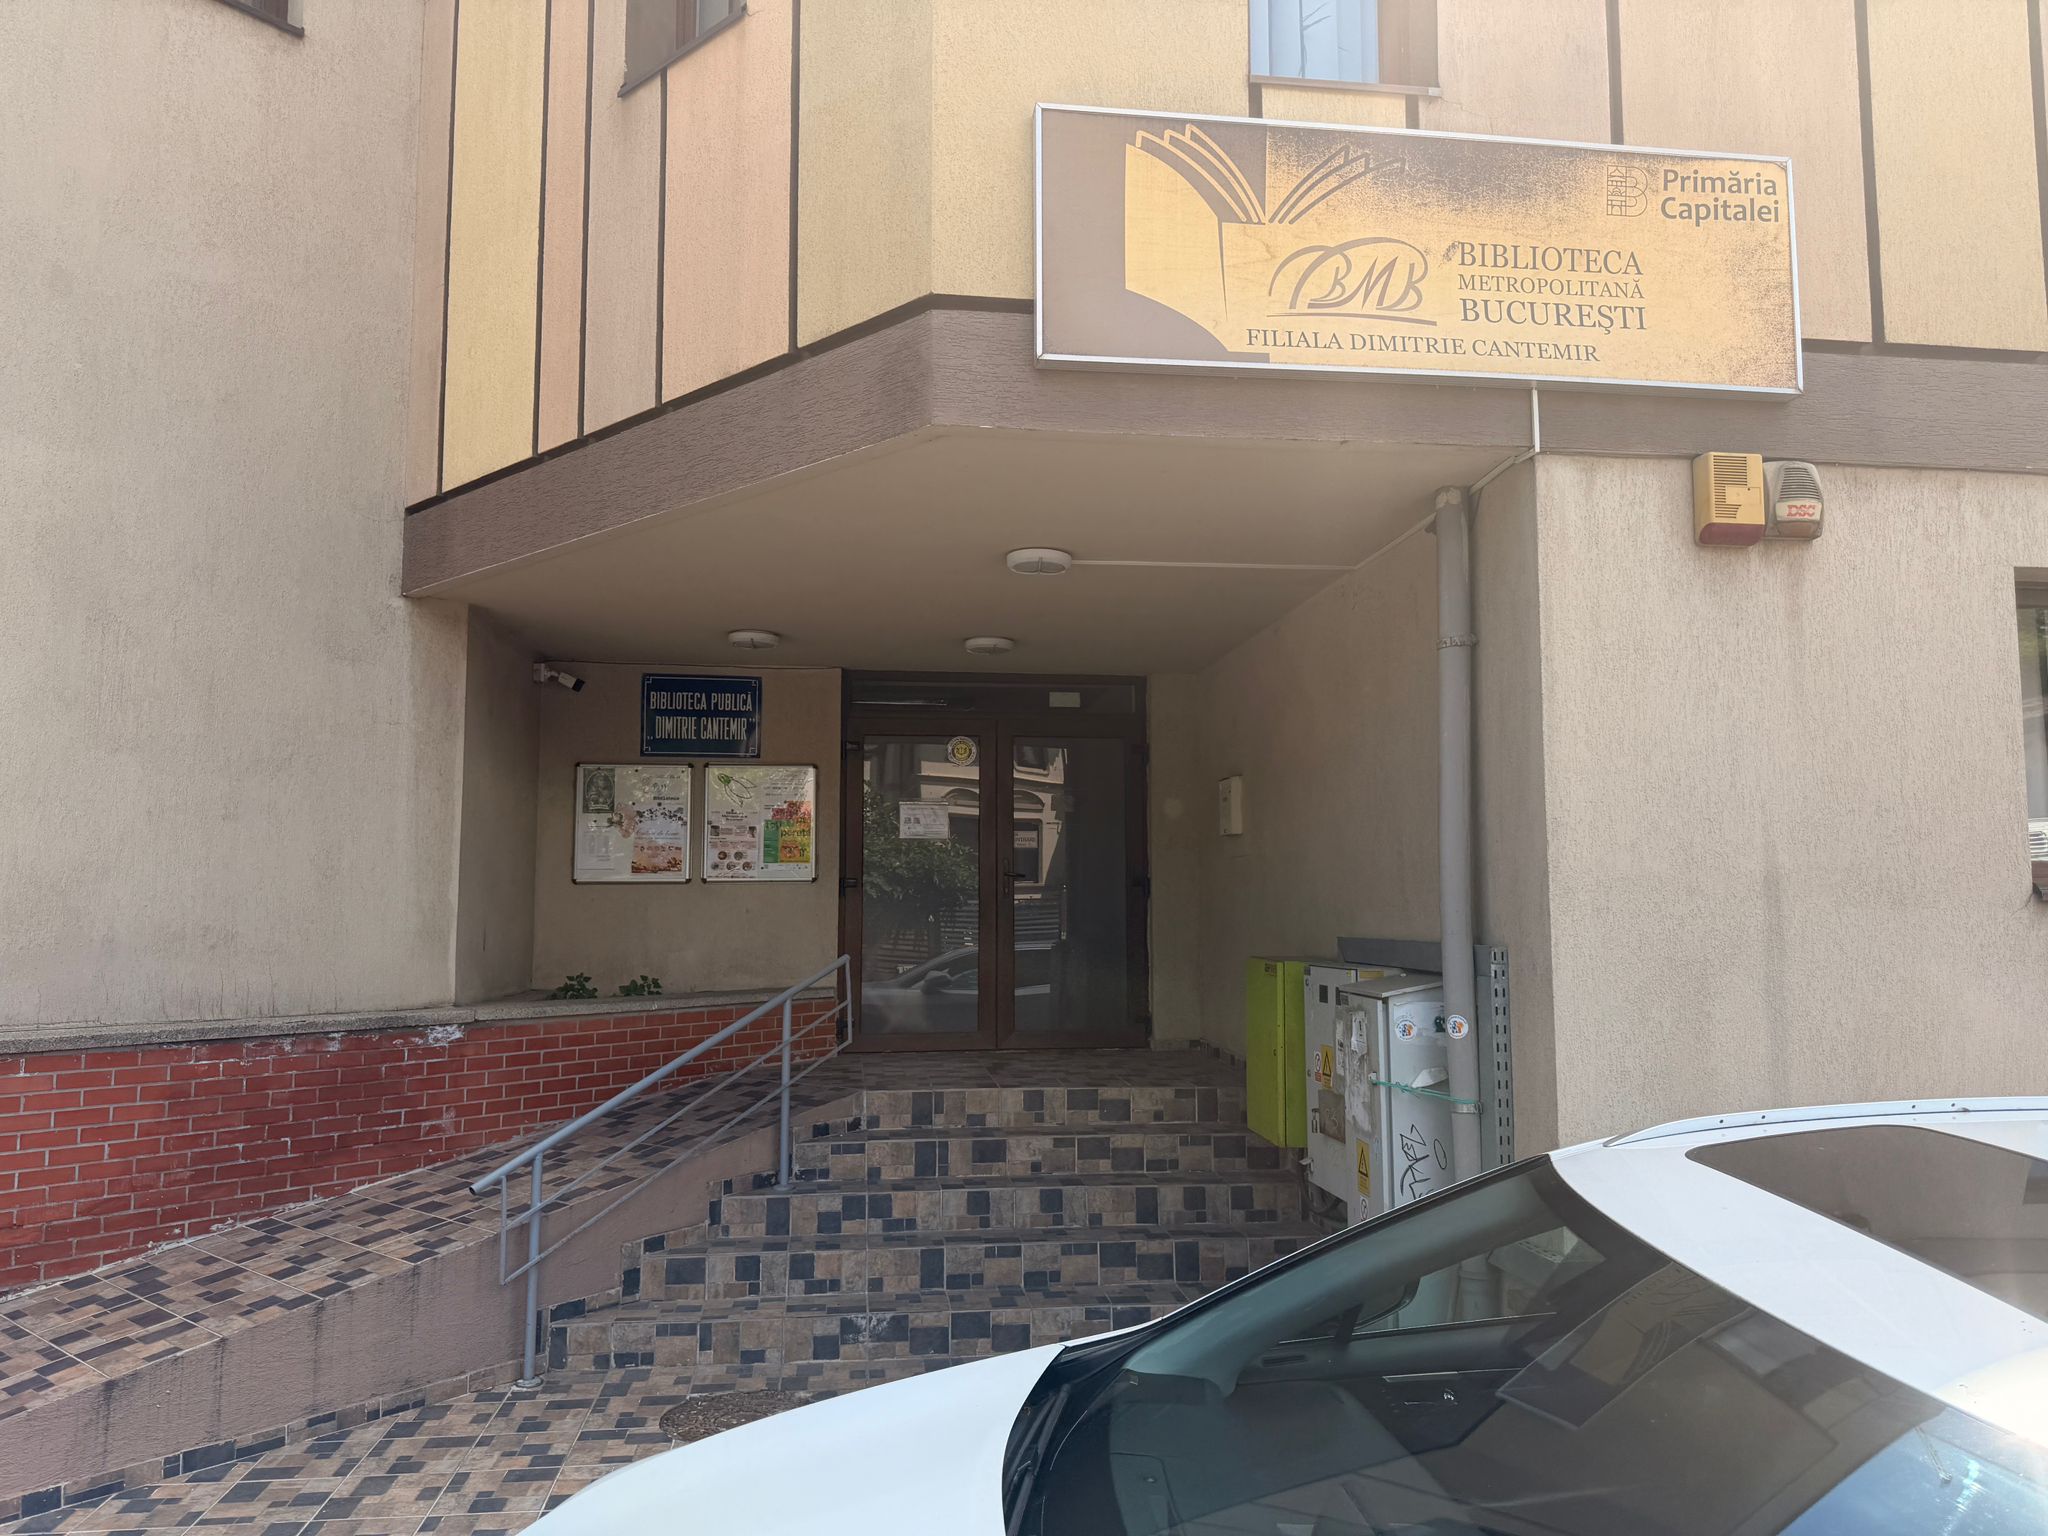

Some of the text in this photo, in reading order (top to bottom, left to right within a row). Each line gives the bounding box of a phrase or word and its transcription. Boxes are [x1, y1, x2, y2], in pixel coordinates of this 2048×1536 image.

[1662, 169, 1777, 196] Primăria
[1661, 197, 1779, 227] Capitalei
[1457, 241, 1643, 275] BIBLIOTECA
[1457, 274, 1644, 299] METROPOLITANĂ
[1246, 328, 1600, 362] FILIALA DIMITRIE CANTEMIR
[650, 691, 707, 710] BIBLIOTECA
